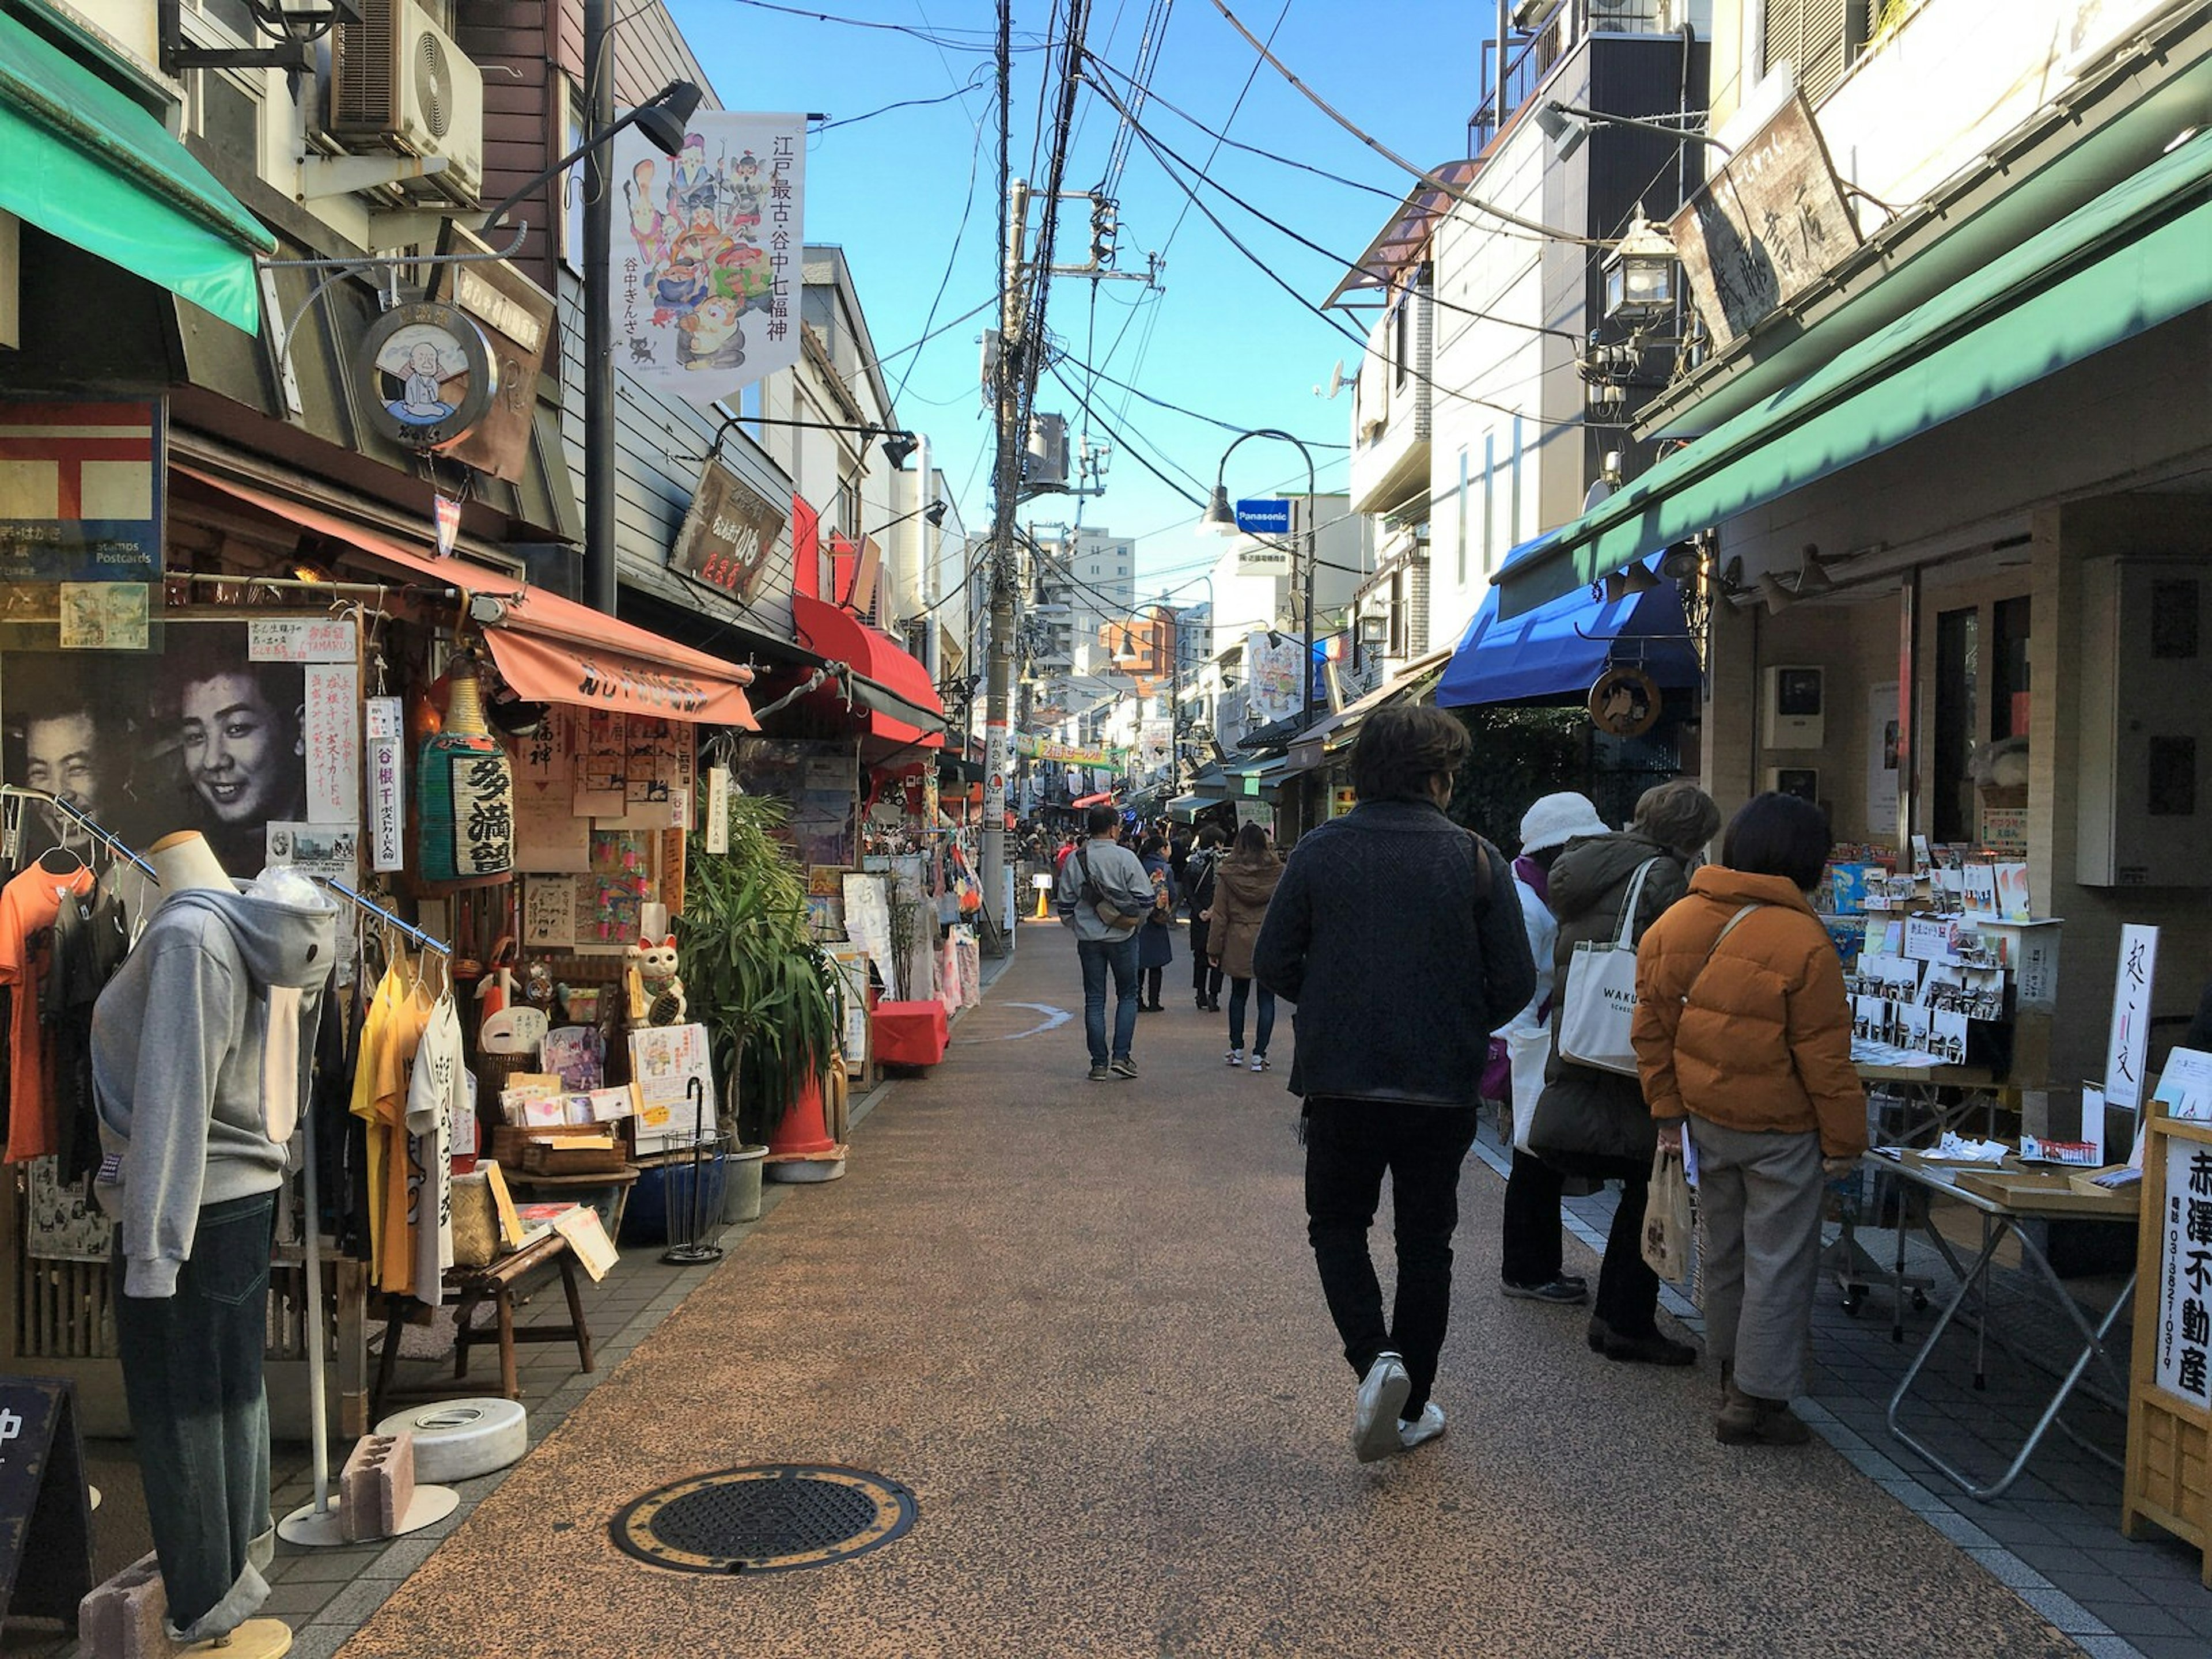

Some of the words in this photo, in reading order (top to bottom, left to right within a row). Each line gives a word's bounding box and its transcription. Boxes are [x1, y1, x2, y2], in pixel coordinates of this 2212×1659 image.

[767, 136, 794, 342] 江戸最古・谷中七福神
[623, 256, 639, 335] 谷中ぎんざ
[1239, 512, 1287, 521] Panasonic
[96, 553, 151, 563] Postcards
[990, 737, 1002, 771] かき氷
